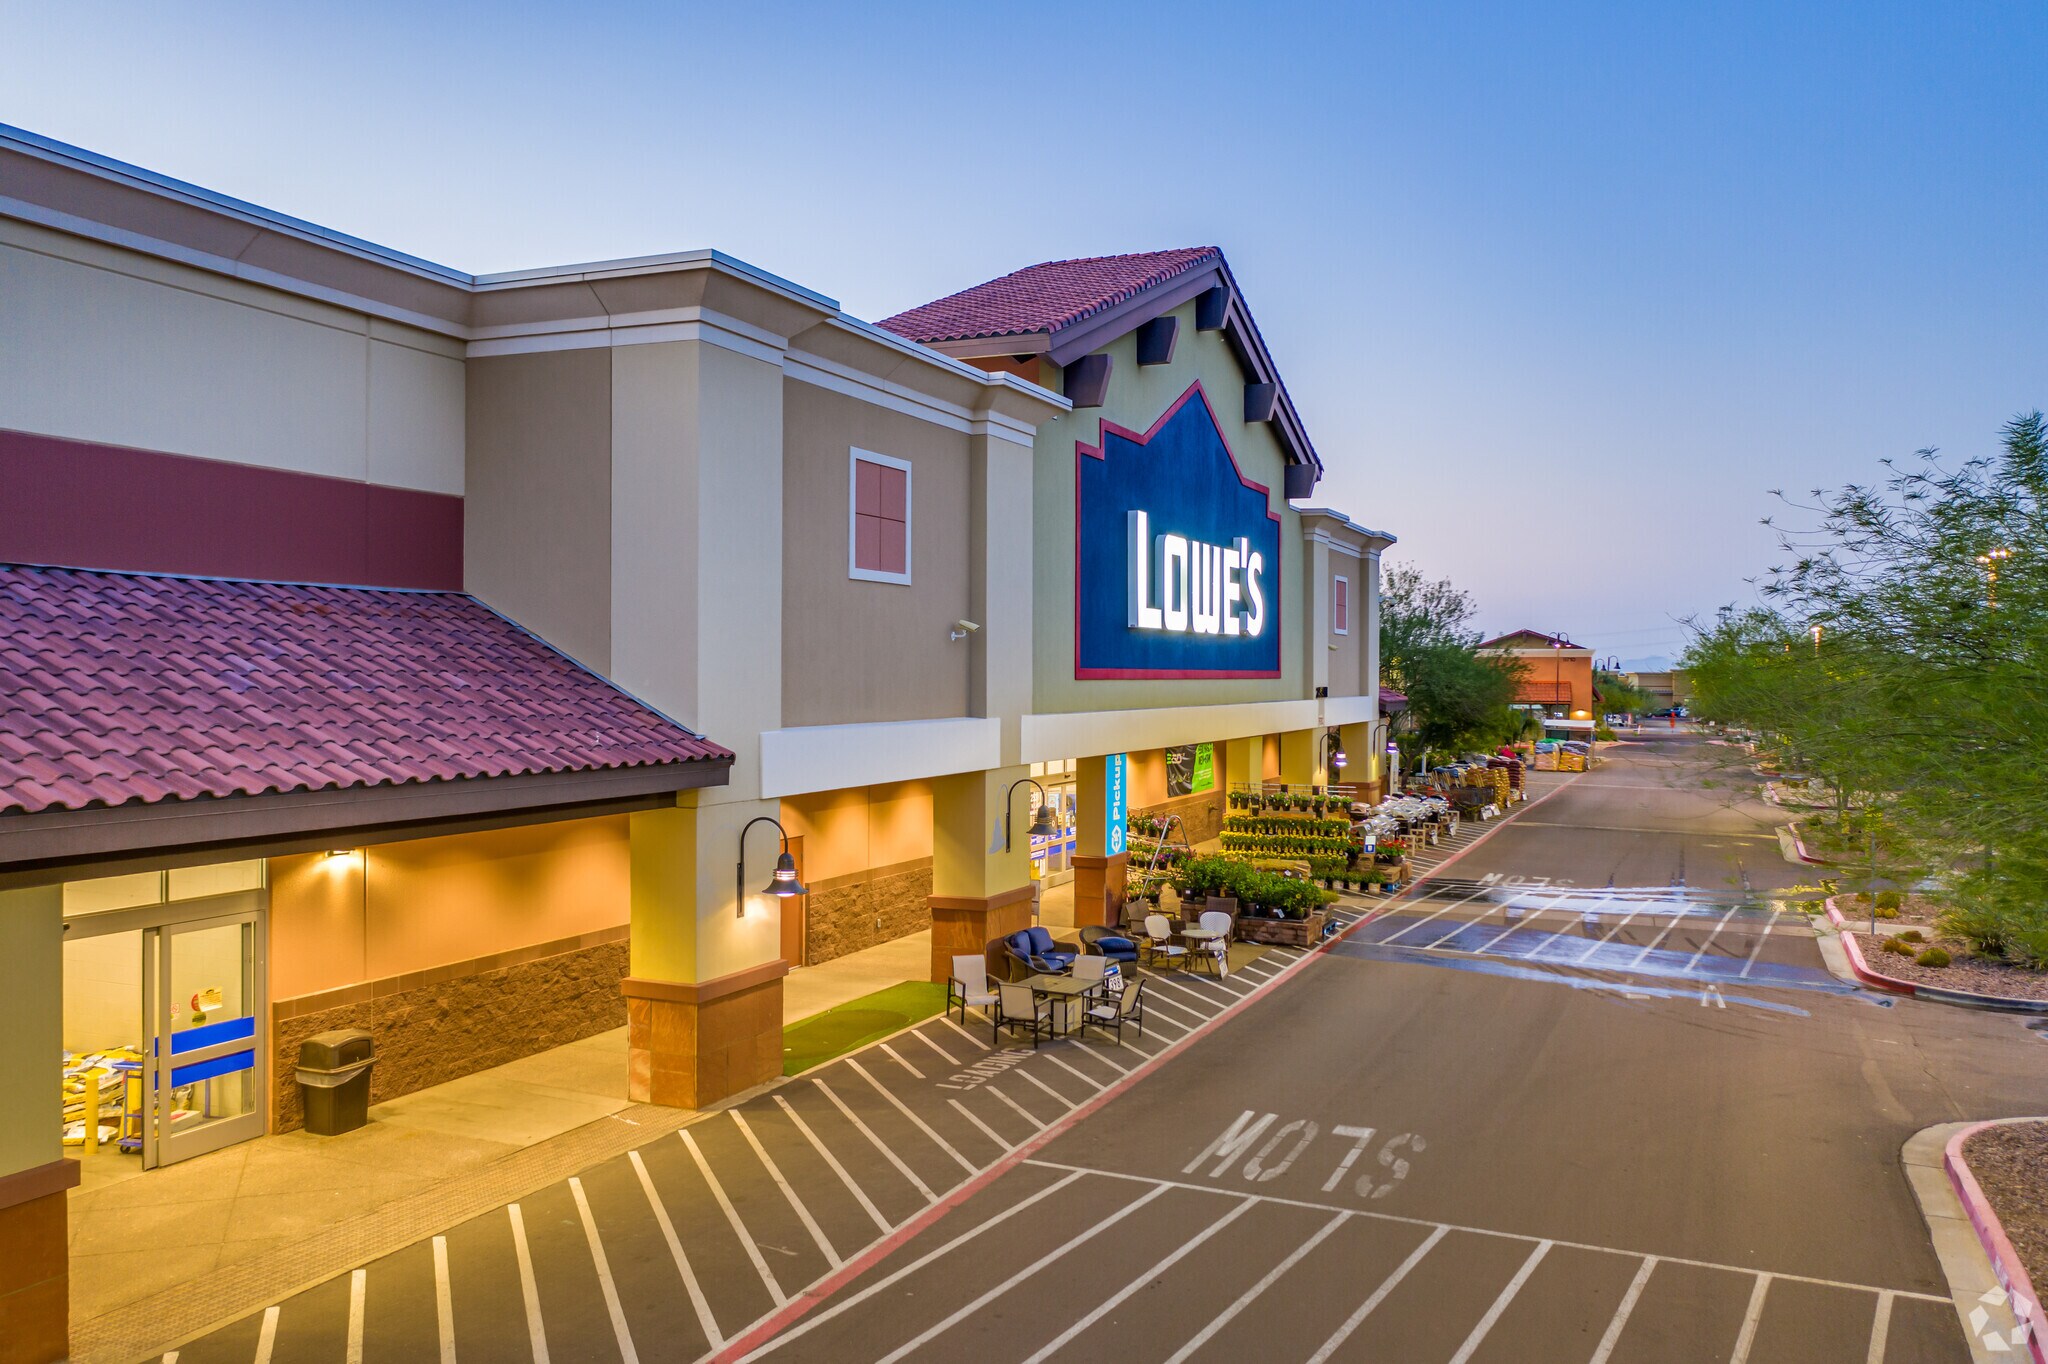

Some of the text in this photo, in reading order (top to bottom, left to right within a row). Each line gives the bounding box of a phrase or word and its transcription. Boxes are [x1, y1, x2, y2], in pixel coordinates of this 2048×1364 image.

[1128, 510, 1264, 637] LOWE'S
[1112, 754, 1122, 821] Pickup
[935, 1048, 1037, 1091] LOADING
[1181, 1109, 1427, 1199] SLOW
